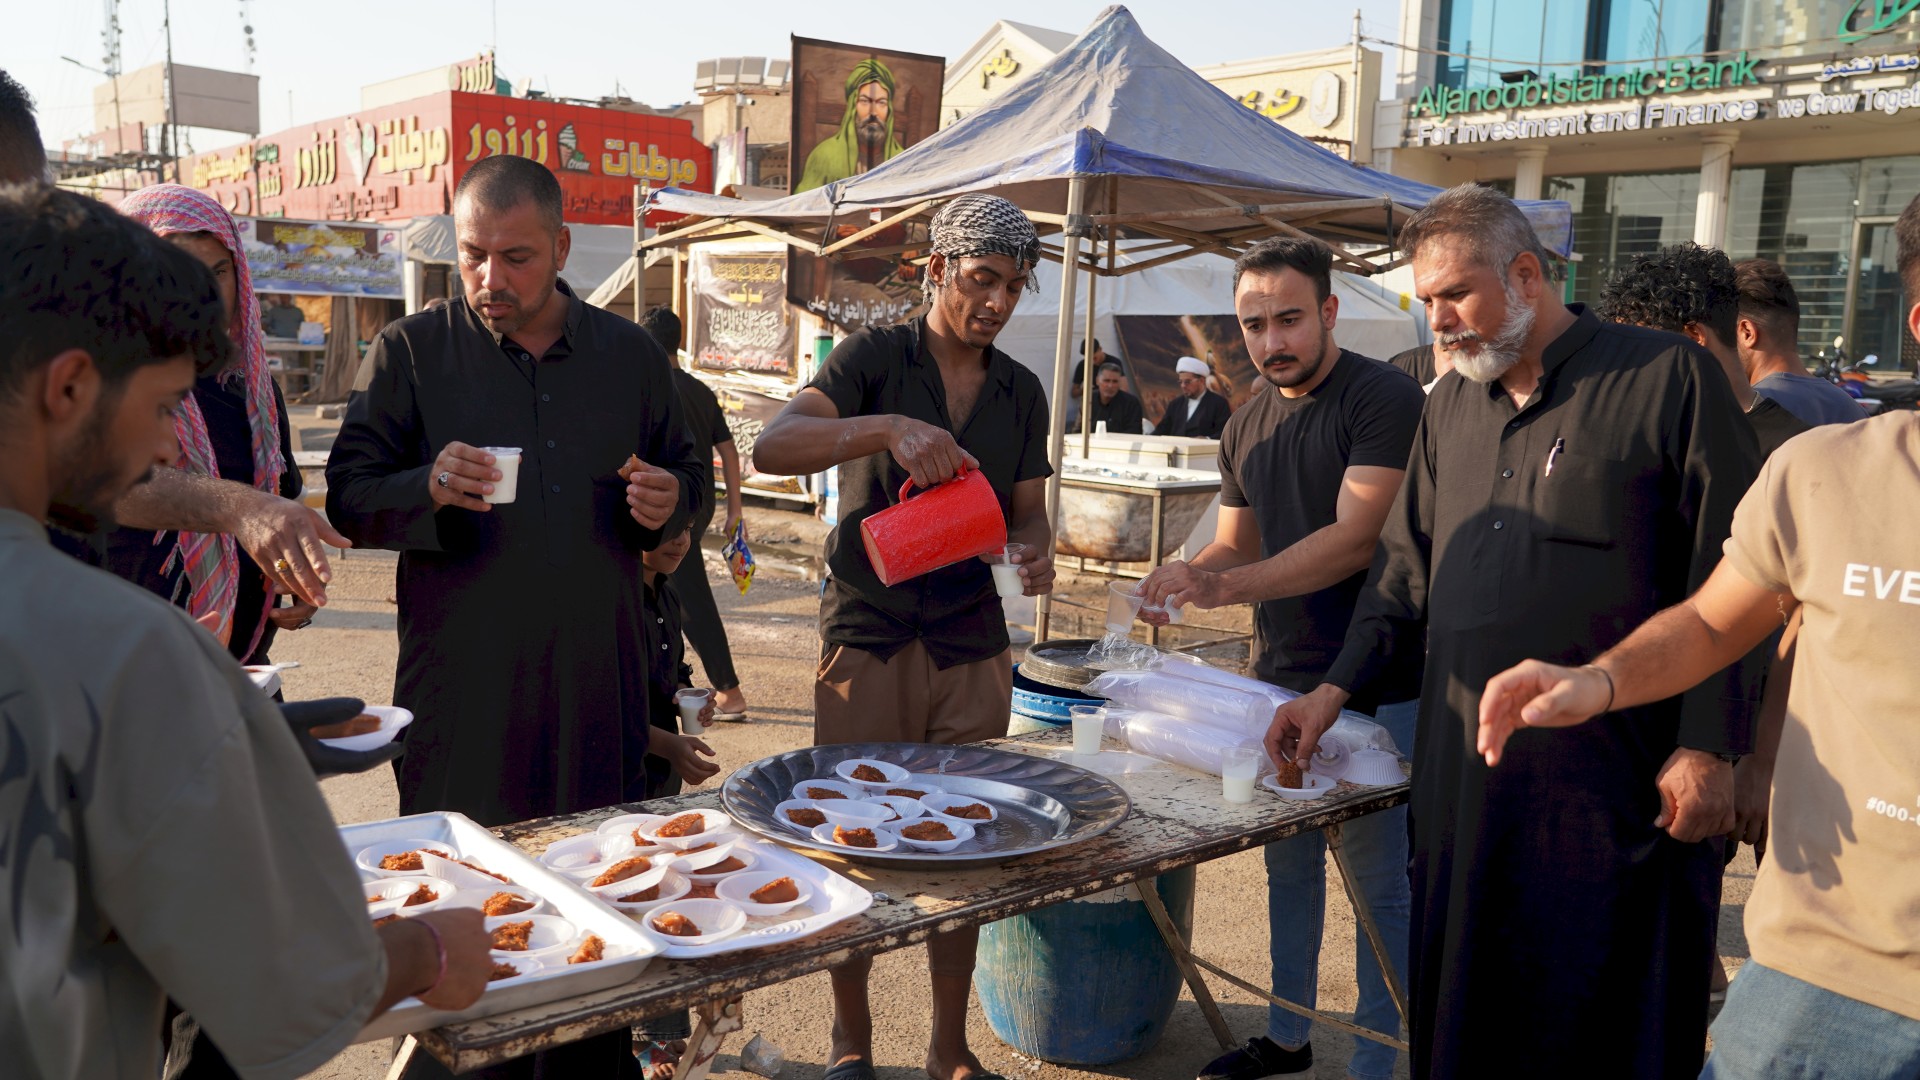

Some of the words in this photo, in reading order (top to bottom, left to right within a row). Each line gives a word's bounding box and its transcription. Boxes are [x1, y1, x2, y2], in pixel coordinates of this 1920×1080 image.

[1412, 73, 1542, 123] Aljanoob
[1546, 66, 1660, 105] Islamic
[1663, 50, 1760, 93] Bank
[1777, 98, 1806, 118] we
[1807, 91, 1860, 115] Grow
[376, 114, 449, 186] مرطبات
[465, 114, 549, 165] زرزور
[1417, 123, 1455, 147] For
[1590, 104, 1642, 133] and
[293, 127, 337, 190] زرزور
[602, 138, 698, 188] مرطبات
[1842, 562, 1920, 606] EVE
